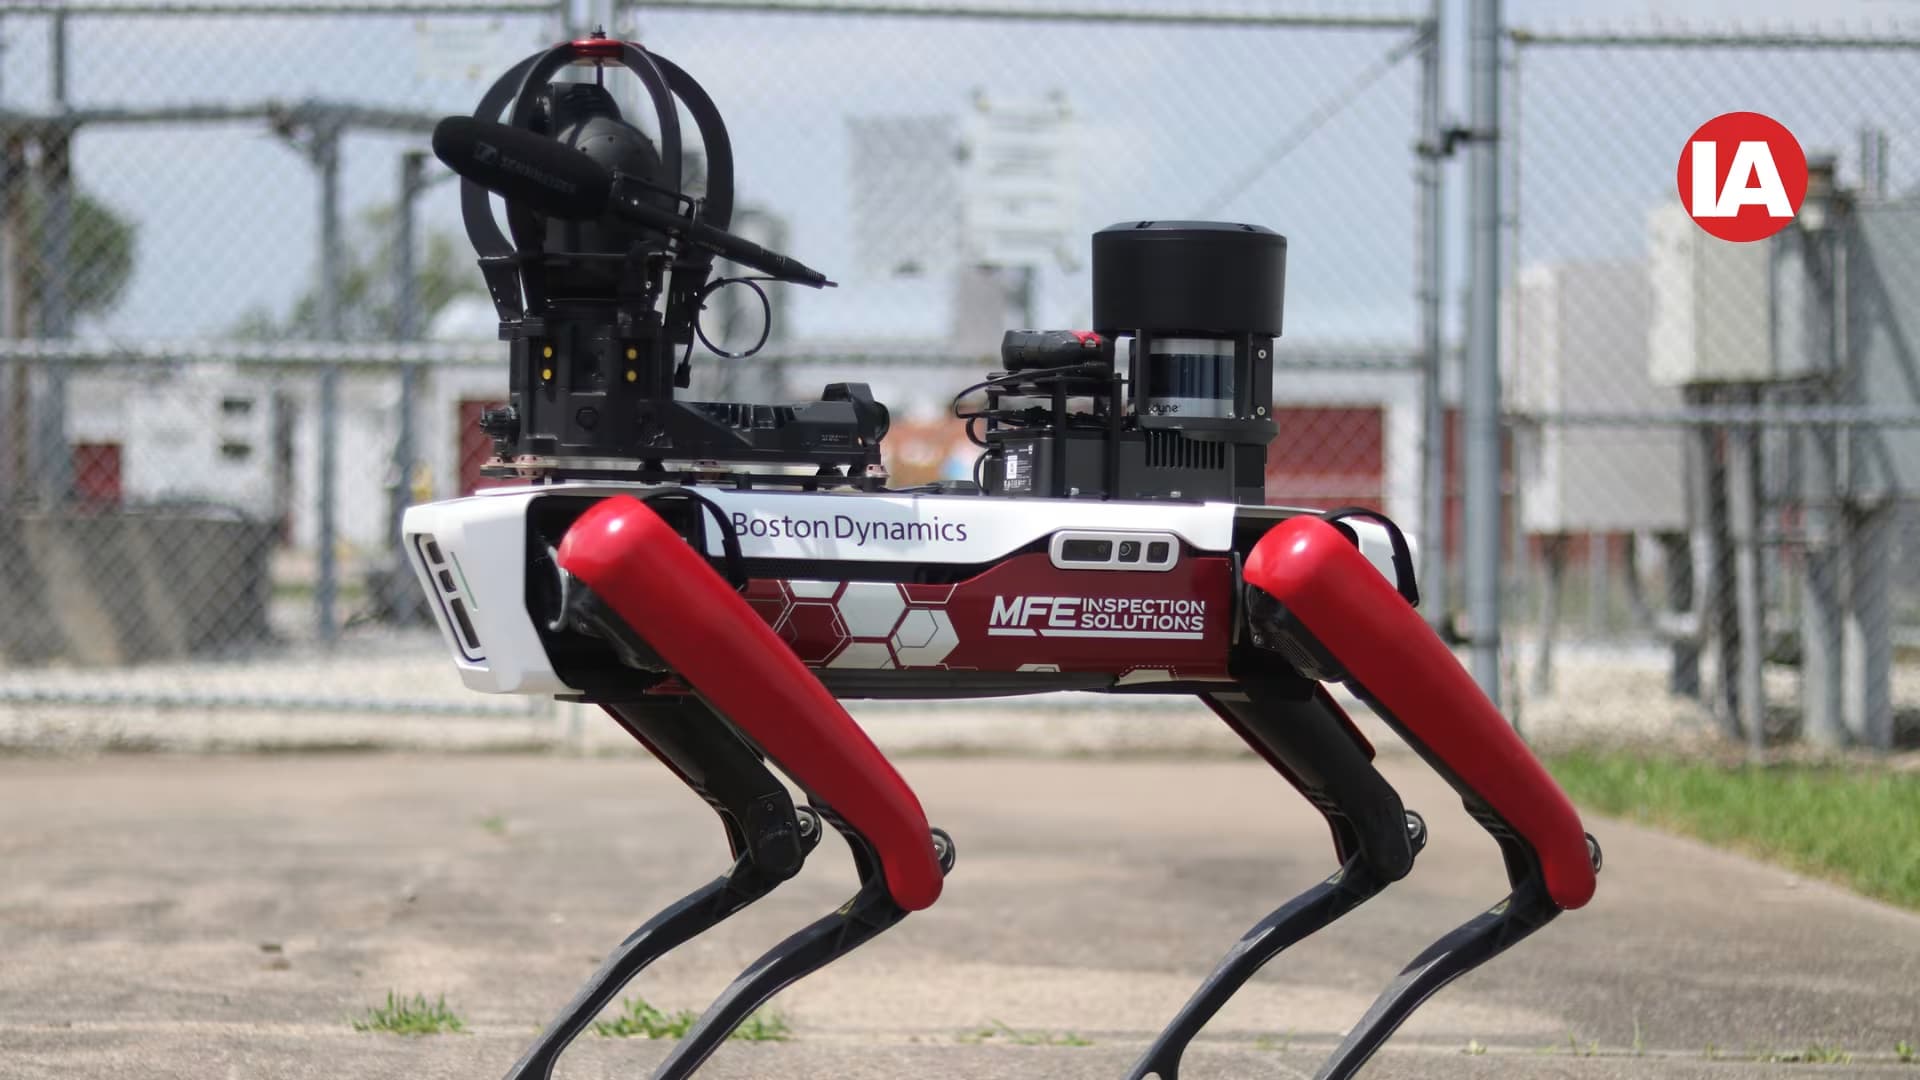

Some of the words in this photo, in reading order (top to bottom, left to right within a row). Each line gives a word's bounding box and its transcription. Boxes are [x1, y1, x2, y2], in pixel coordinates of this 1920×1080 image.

[732, 512, 829, 539] Boston
[834, 515, 968, 546] Dynamics
[989, 595, 1082, 627] MFE
[1082, 597, 1205, 615] INSPECTION
[1080, 613, 1204, 630] SOLUTIONS
